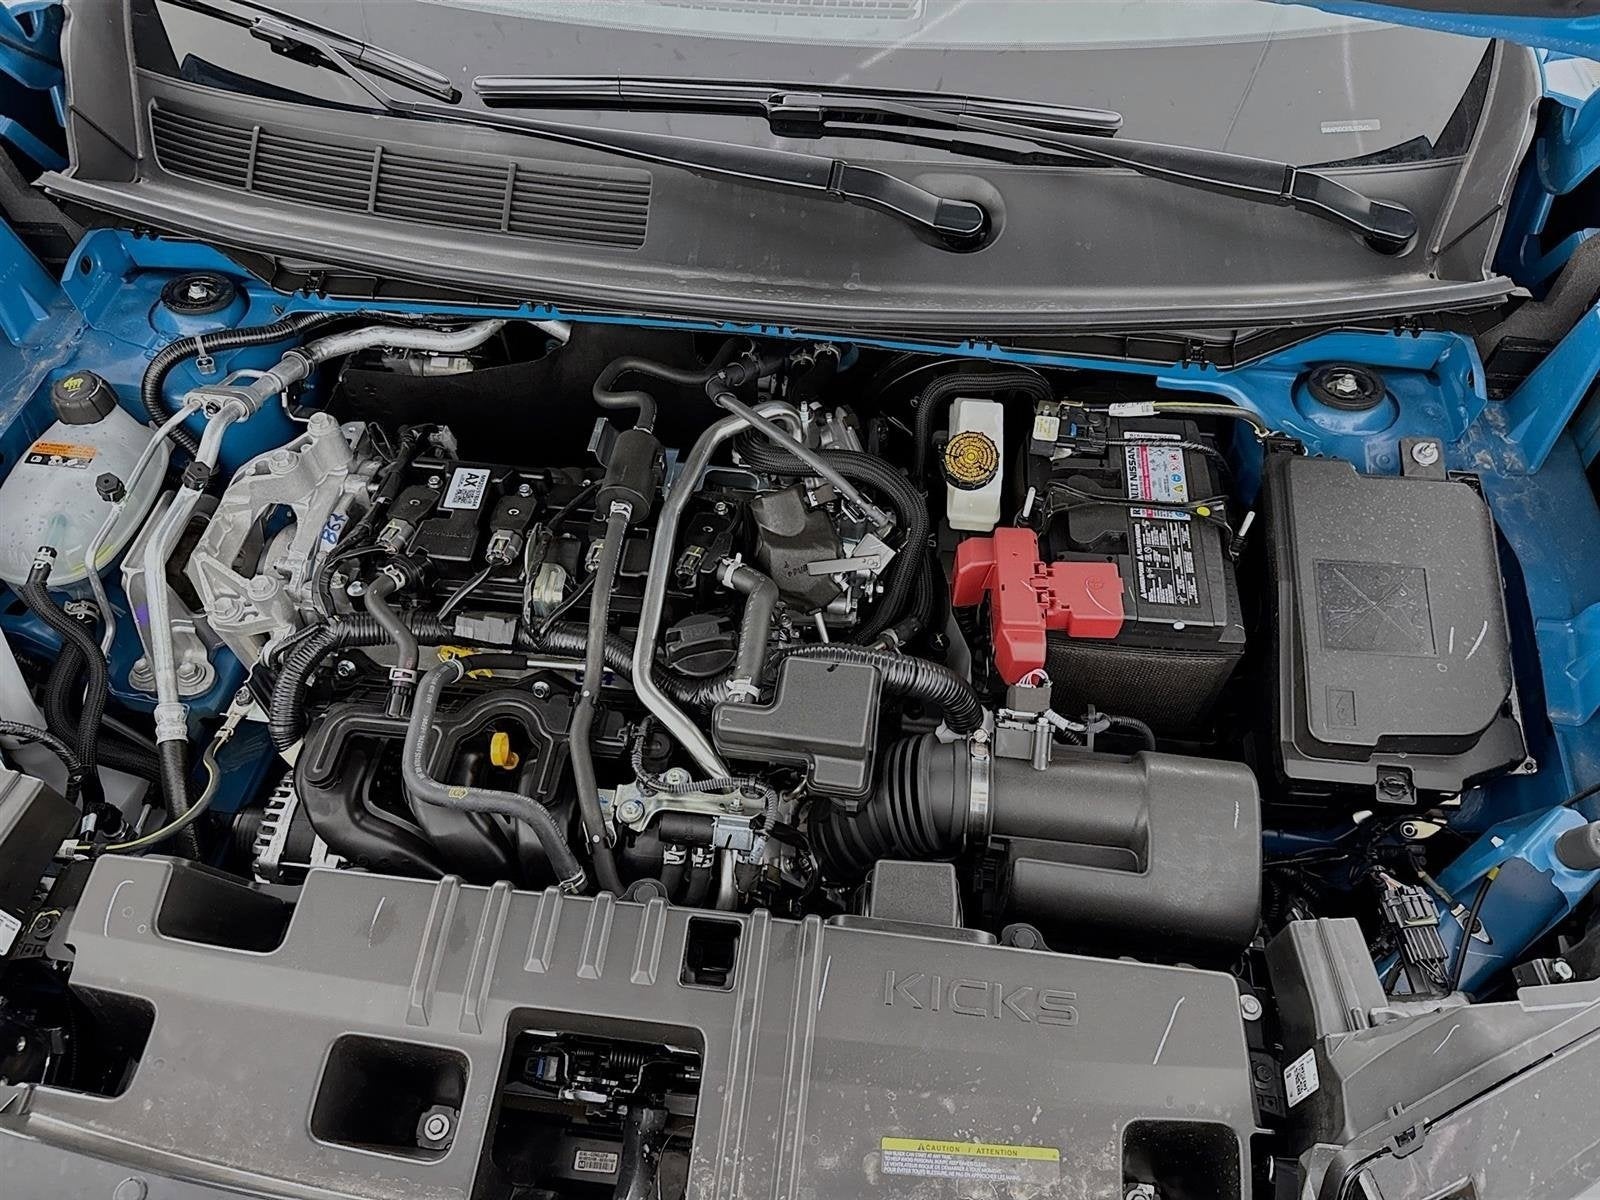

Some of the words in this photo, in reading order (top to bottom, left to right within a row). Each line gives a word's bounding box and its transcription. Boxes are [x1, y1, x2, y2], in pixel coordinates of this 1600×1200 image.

[1125, 447, 1138, 481] NISSAN
[464, 472, 479, 487] AX
[884, 970, 1079, 1026] KICKS
[925, 1144, 960, 1153] CAUTION
[976, 1147, 1018, 1157] ATTENTION
